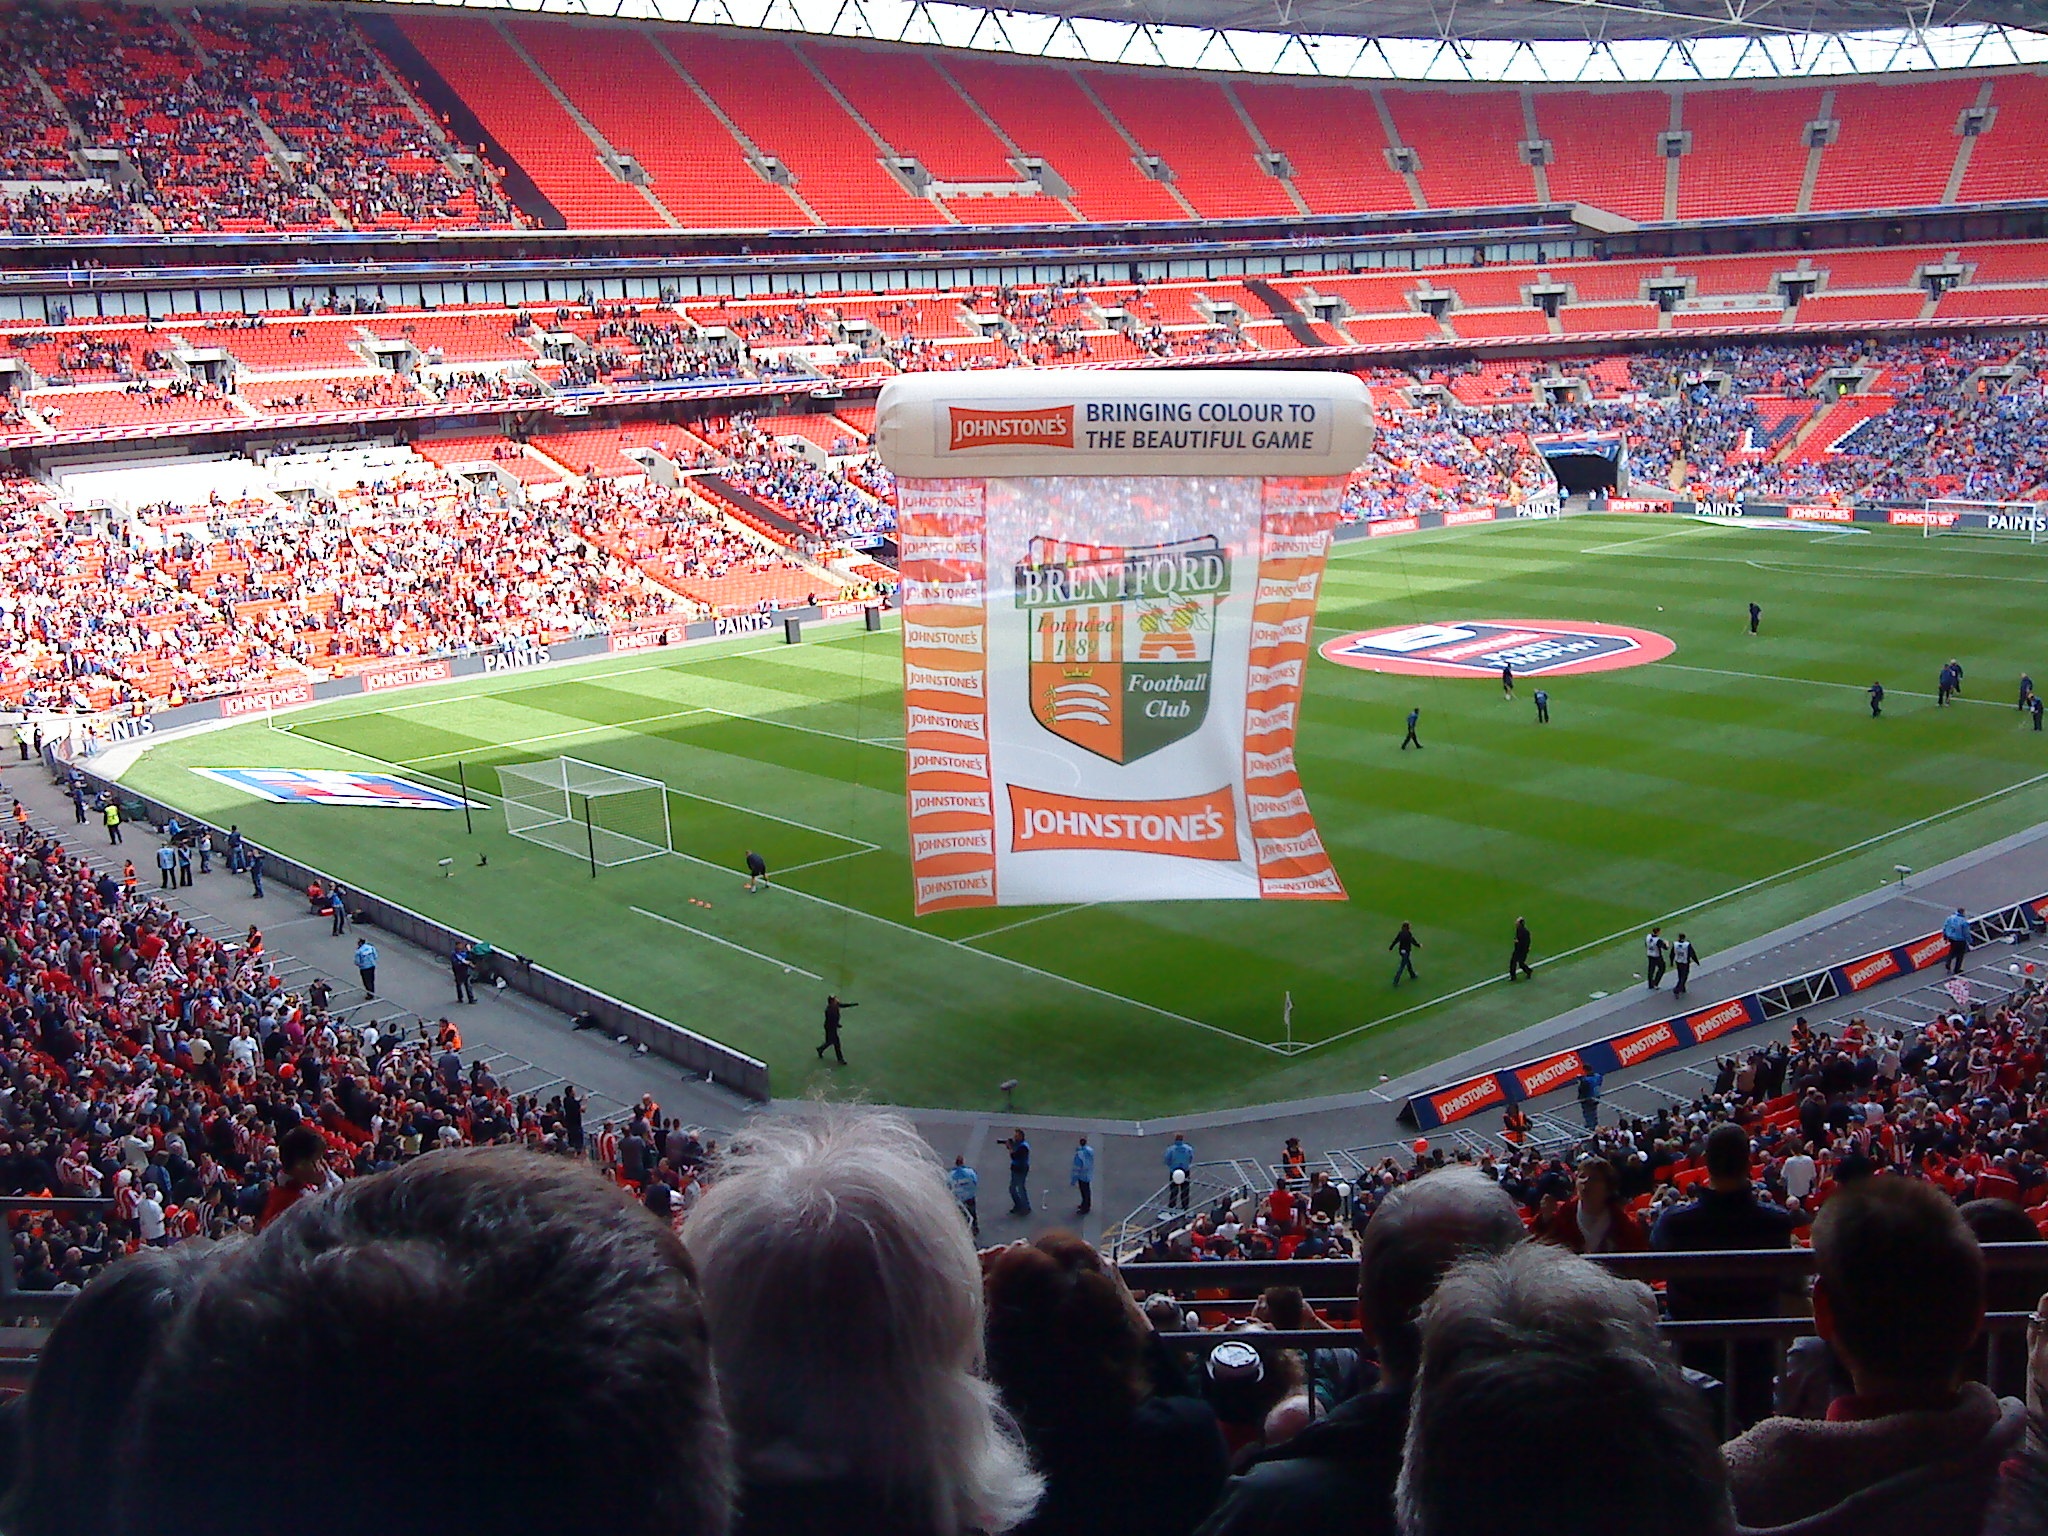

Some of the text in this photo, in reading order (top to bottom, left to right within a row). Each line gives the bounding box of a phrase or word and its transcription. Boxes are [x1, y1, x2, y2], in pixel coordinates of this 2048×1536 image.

[1086, 403, 1316, 423] BRINGING COLOUR TO
[955, 413, 1068, 443] JOHNSTONE'S
[1086, 430, 1314, 449] THE BEAUTIFUL GAME
[1515, 503, 1560, 518] PAINTS
[1695, 502, 1743, 517] PAINTS
[1988, 514, 2046, 531] PAINTS
[1023, 554, 1224, 605] BRENTFORD
[715, 612, 773, 637] PAINTS
[1037, 615, 1118, 634] Founded
[908, 629, 978, 645] JOHNSTONE'S
[1055, 639, 1098, 656] 1889
[484, 648, 551, 673] PAINTS
[909, 671, 978, 689] JOHNSTONE'S
[1128, 673, 1207, 693] Football
[1144, 700, 1191, 718] Club
[911, 713, 979, 731] JOHNSTONE'S
[913, 755, 982, 771] JOHNSTONE'S
[915, 795, 986, 812] JOHNSTONE'S
[1020, 804, 1225, 844] JOHNSTONE'S
[918, 833, 987, 854] JOHNSTONE'S
[921, 875, 988, 898] JOHNSTONE'S
[1694, 1002, 1743, 1041] JOHNSTONE'S
[1618, 1025, 1671, 1065] JOHNSTONE'S
[1523, 1053, 1579, 1093] JOHNSTONE'S
[1438, 1078, 1497, 1120] JOHNSTONE'S
